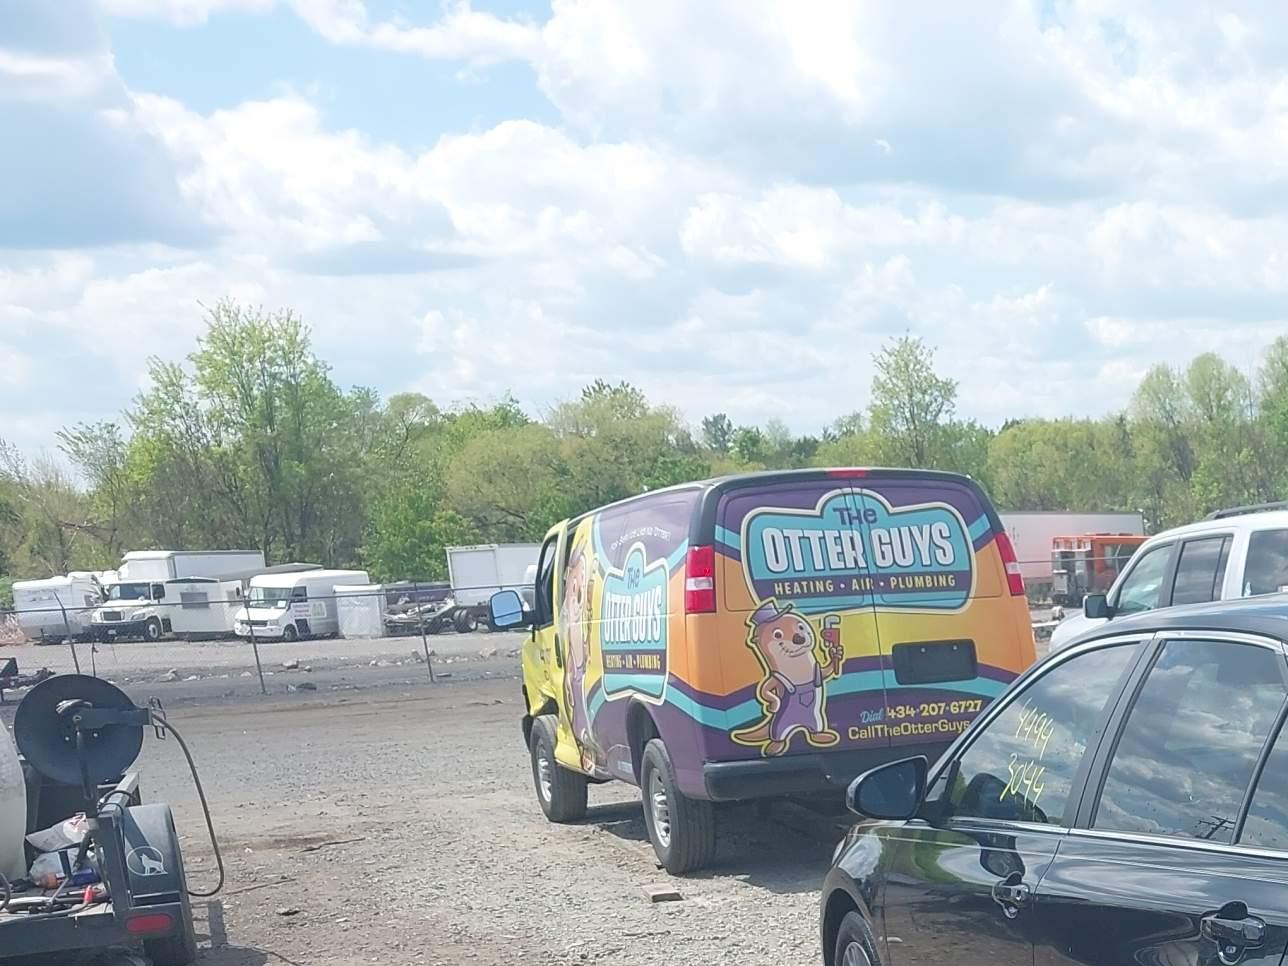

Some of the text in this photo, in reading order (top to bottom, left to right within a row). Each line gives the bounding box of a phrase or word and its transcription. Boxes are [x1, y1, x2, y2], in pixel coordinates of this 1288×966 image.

[762, 521, 955, 573] OTTER GUYS
[774, 574, 956, 595] HEATING AIR PLUMBING
[604, 585, 662, 642] OTTER GUYS
[860, 707, 884, 724] Dial
